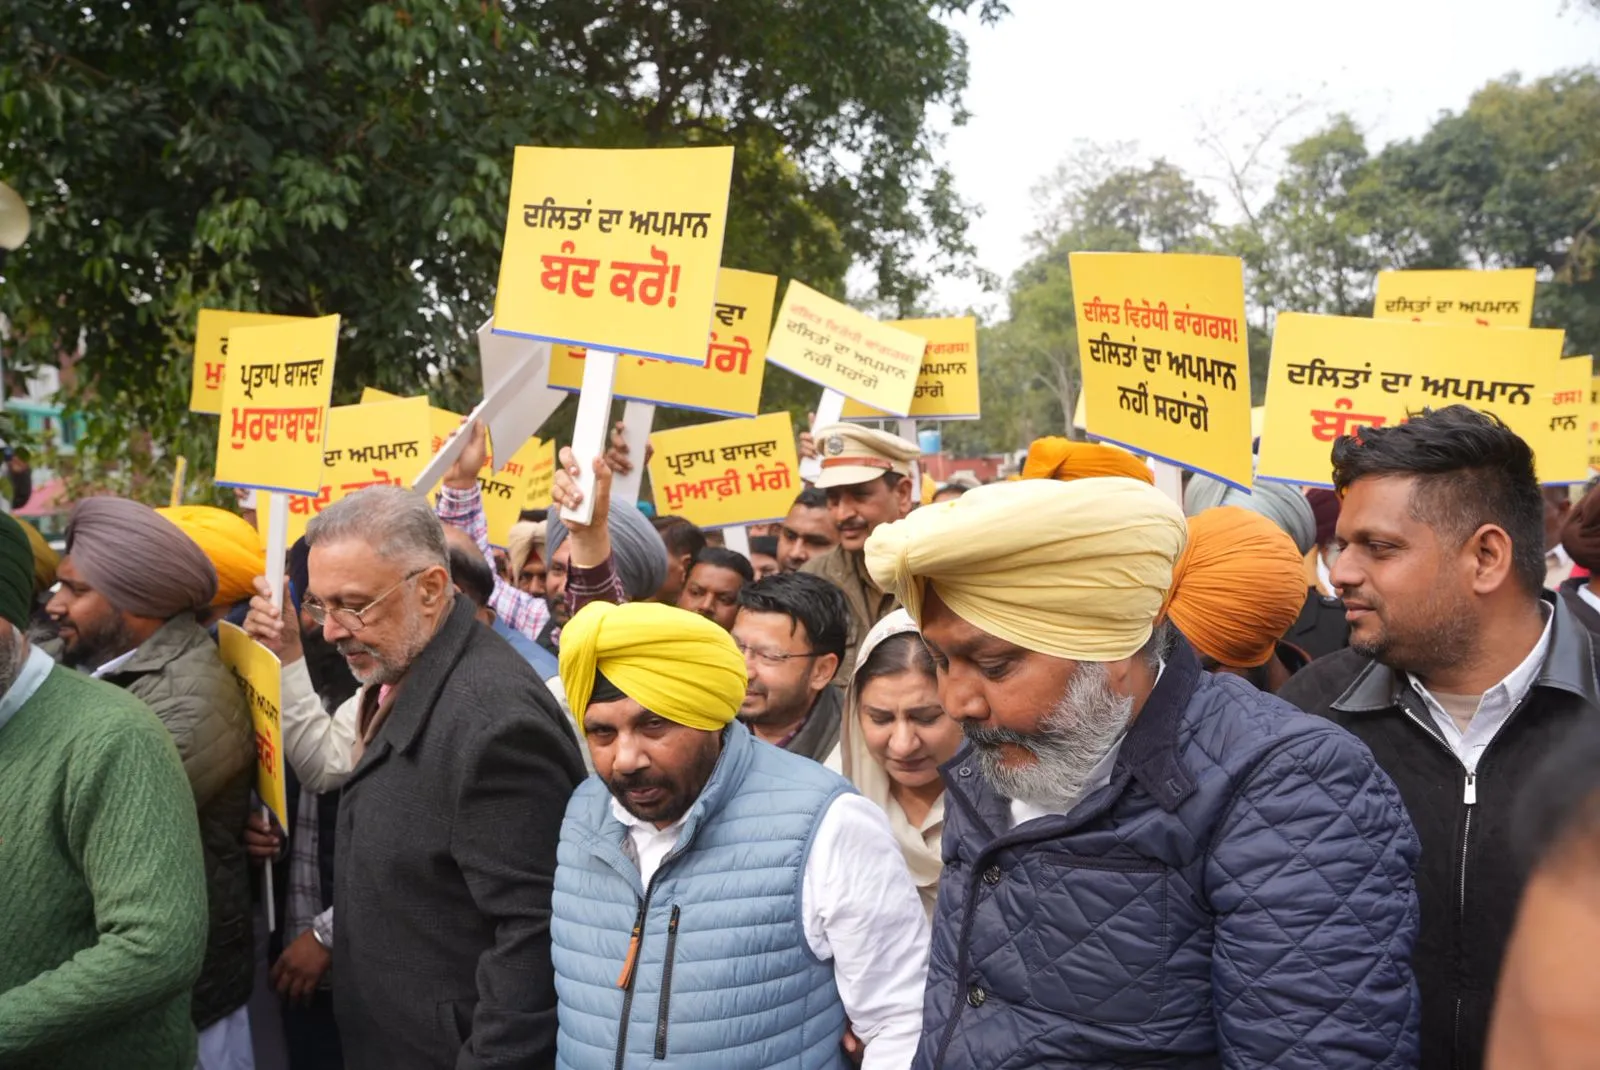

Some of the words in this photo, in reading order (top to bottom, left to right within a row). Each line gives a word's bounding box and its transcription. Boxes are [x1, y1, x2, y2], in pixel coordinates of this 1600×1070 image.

[523, 197, 592, 231] ਦਲਿਤਾਂ
[598, 208, 623, 233] ਦਾ
[629, 210, 711, 238] ਅਪਮਾਨ
[540, 240, 600, 298] ਬੰਦ
[609, 245, 681, 308] ਕਰੋ!
[1083, 296, 1120, 325] ਦਲਿਤ
[1123, 298, 1169, 331] ਵਿਰੋਧੀ
[1173, 304, 1239, 343] ਕਾਂਗਰਸ!
[1436, 300, 1454, 313] ਦਾ
[1459, 300, 1521, 314] ਅਪਮਾਨ
[241, 363, 280, 400] ਪ੍ਰਤਾਪ
[284, 358, 324, 387] ਬਾਜਵਾ
[1088, 332, 1137, 367] ਦਲਿਤਾਂ
[1142, 347, 1162, 373] ਦਾ
[1166, 351, 1237, 391] ਅਪਮਾਨ
[1286, 358, 1372, 390] ਦਲਿਤਾਂ
[1380, 371, 1412, 393] ਦਾ
[1421, 376, 1535, 405] ਅਪਮਾਨ
[231, 406, 323, 450] ਮੁਰਦਾਬਾਦ!
[1117, 381, 1148, 416] ਨਹੀਂ
[1153, 391, 1208, 432] ਸਹਾਂਗੇ
[348, 440, 419, 463] ਅਪਮਾਨ
[665, 449, 716, 476] ਪ੍ਰਤਾਪ
[720, 440, 777, 461] ਬਾਜਵਾ
[663, 468, 740, 510] ਮੁਆਫ਼ੀ
[747, 461, 791, 491] ਮੰਗੇ
